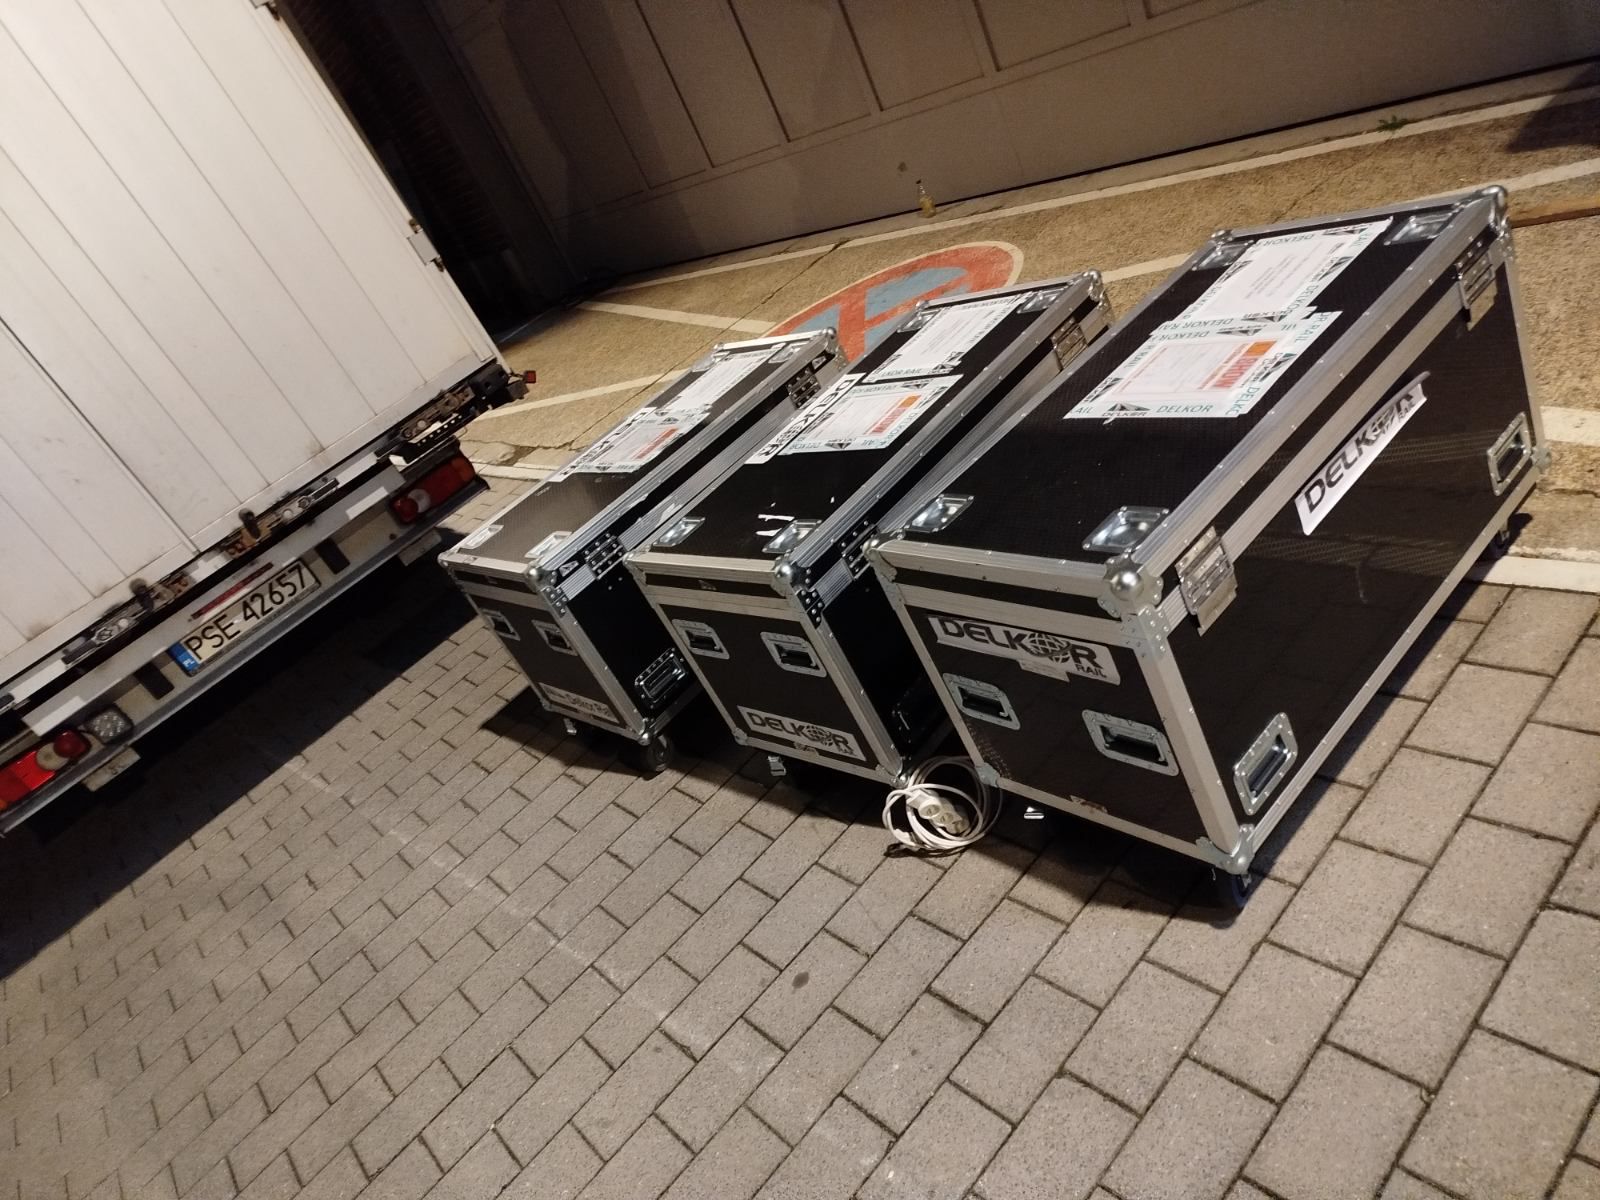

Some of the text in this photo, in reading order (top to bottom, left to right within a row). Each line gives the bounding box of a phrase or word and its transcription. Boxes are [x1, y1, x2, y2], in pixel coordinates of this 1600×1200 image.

[1156, 404, 1214, 414] DELKOR
[184, 564, 307, 660] PSE 42657
[938, 618, 1105, 669] DELKOR
[1075, 663, 1107, 679] RAIL
[746, 711, 853, 752] DELKOR
